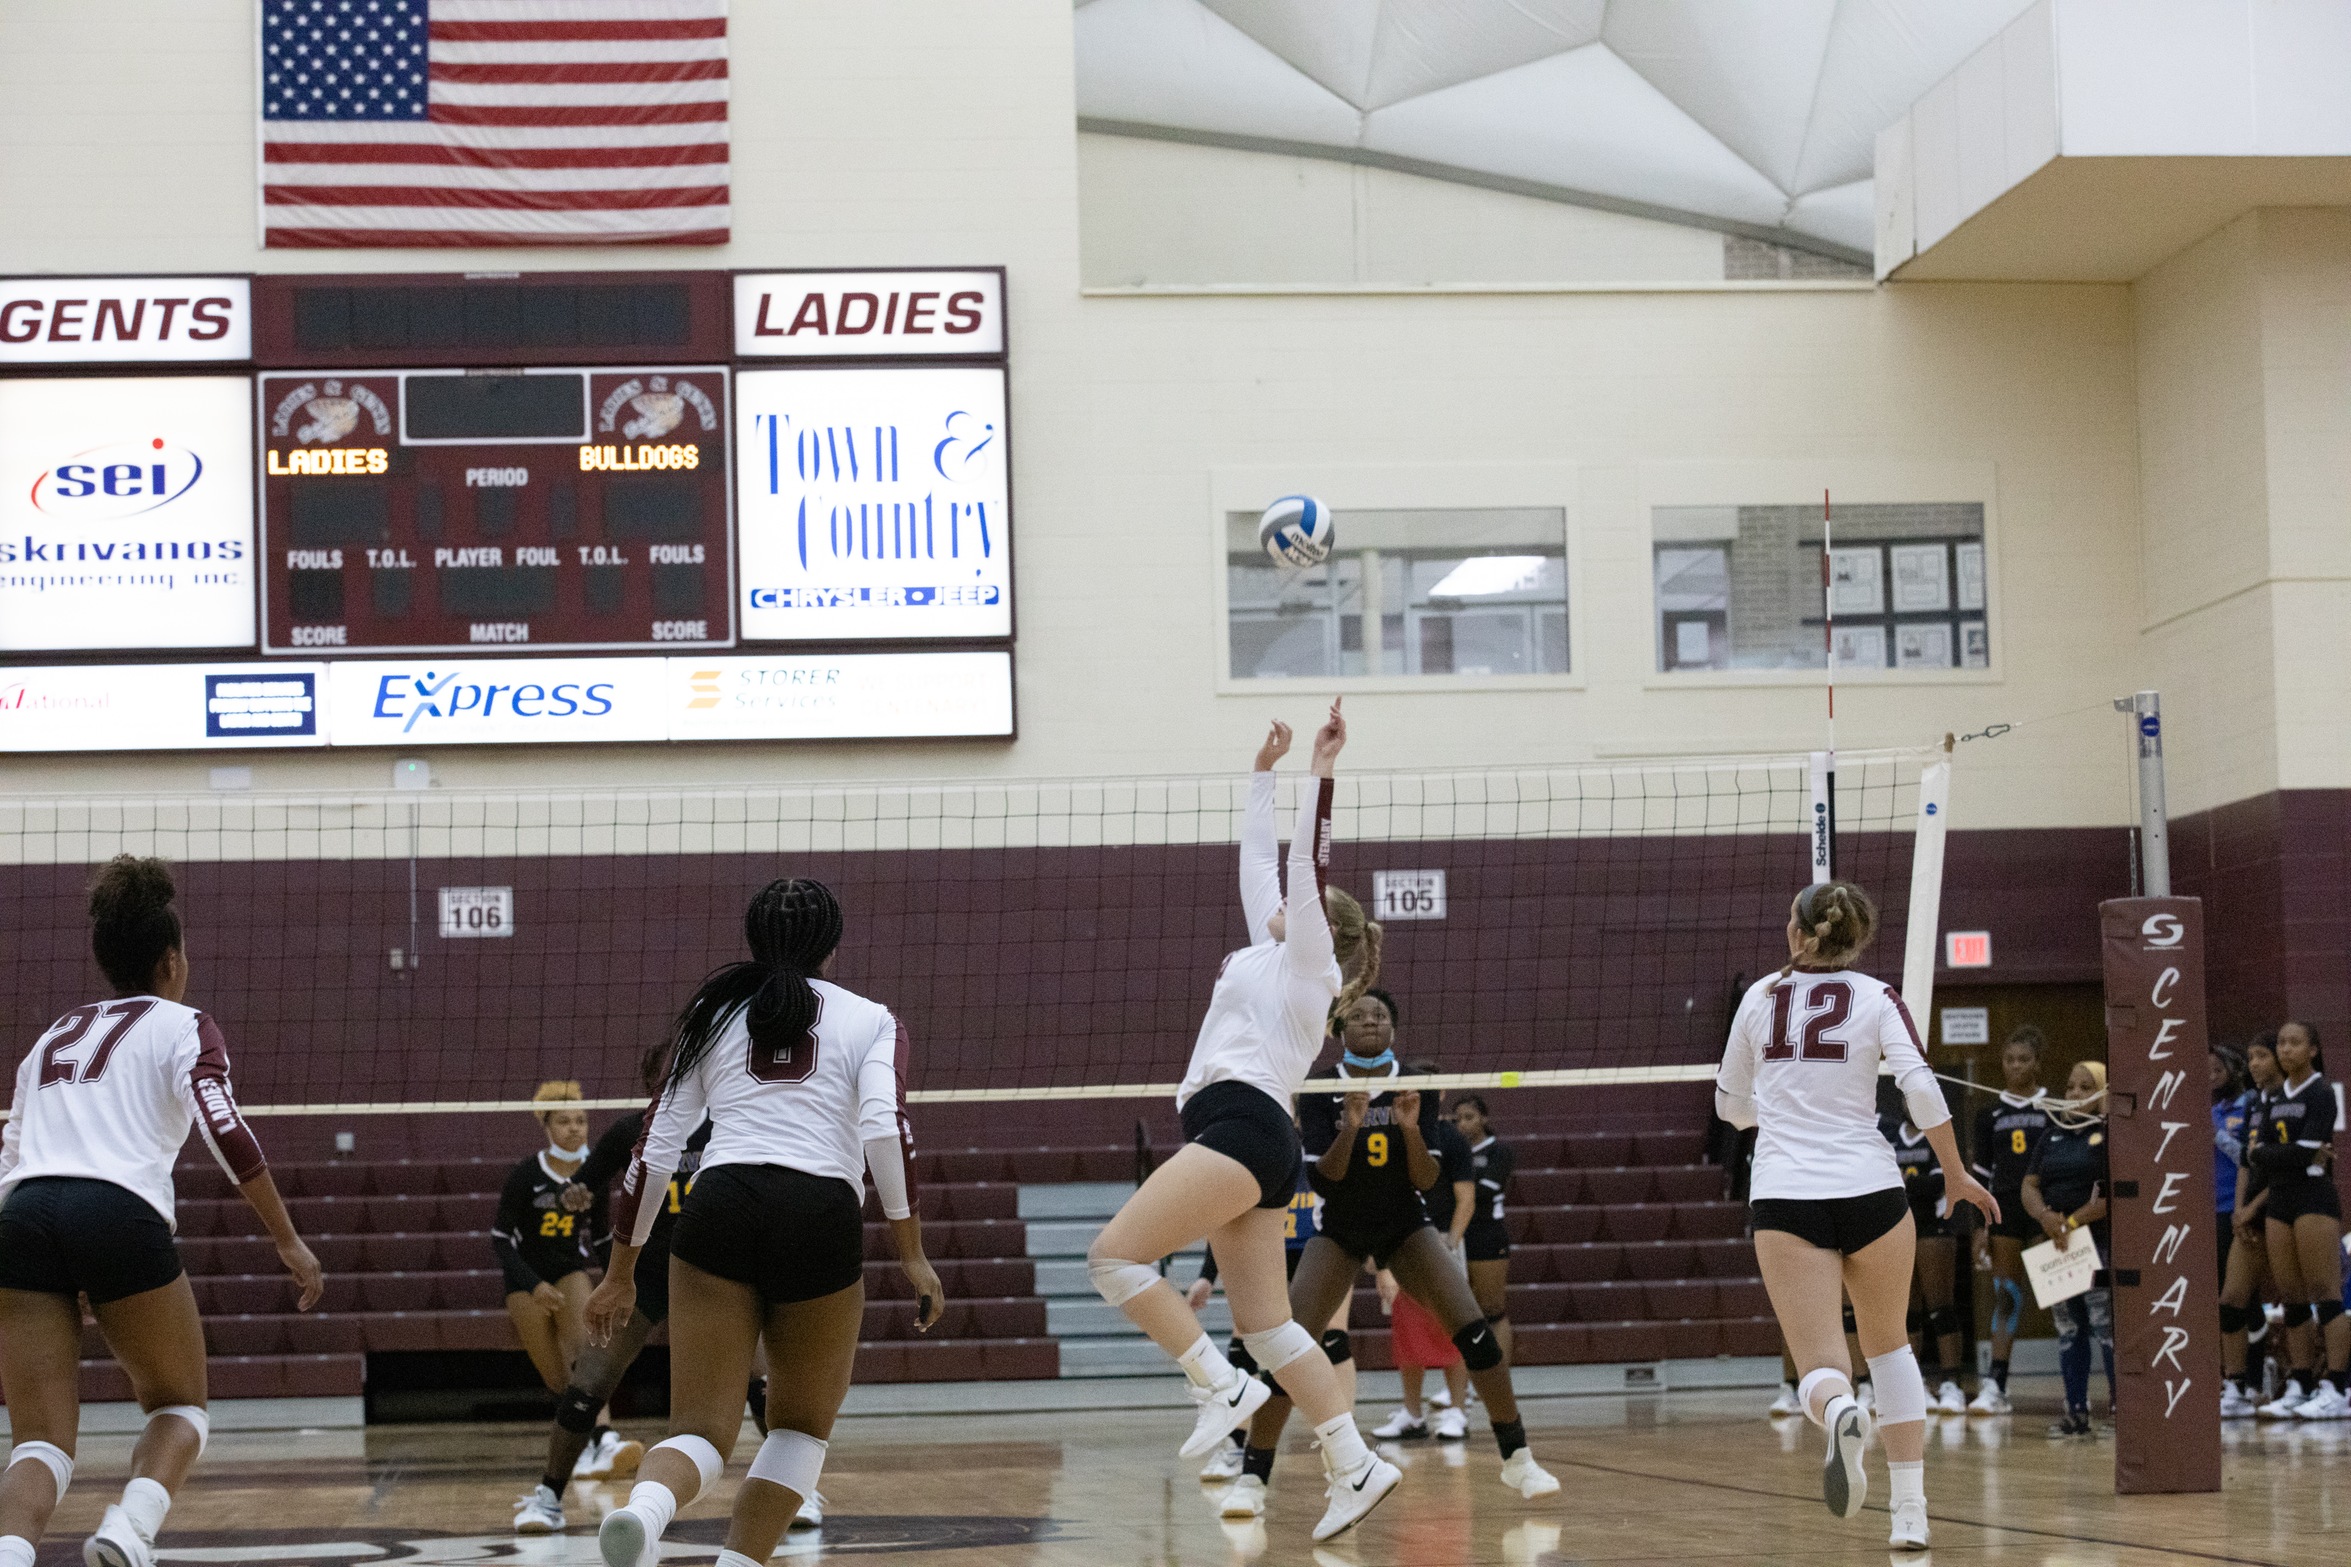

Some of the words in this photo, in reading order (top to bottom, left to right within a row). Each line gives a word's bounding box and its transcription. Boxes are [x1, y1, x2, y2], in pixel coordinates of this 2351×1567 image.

[0, 297, 233, 342] GENTS
[754, 290, 985, 337] LADIES
[268, 449, 389, 475] LADIES
[579, 444, 699, 471] BULLDOGS
[755, 414, 899, 495] Town
[934, 410, 994, 483] &
[56, 438, 167, 497] sei
[466, 467, 528, 487] PERIOD
[797, 492, 999, 577] Country
[0, 536, 243, 563] skrivanos
[287, 550, 343, 569] FOULS
[365, 549, 417, 568] T.O.L.
[435, 548, 502, 568] PLAYER
[516, 547, 560, 566] FOUL
[578, 547, 628, 566] T.O.L.
[650, 546, 705, 564] FOULS
[755, 587, 906, 608] CHRYSLER
[928, 586, 998, 606] JEEP
[291, 626, 347, 646] SCORE
[470, 623, 528, 643] MATCH
[652, 621, 707, 640] SCORE
[740, 668, 840, 687] STORER
[1816, 815, 1826, 866] Schelde
[1388, 890, 1433, 912] 105
[452, 906, 501, 929] 106
[1762, 980, 1855, 1062] 12
[38, 1000, 159, 1091] 27
[1367, 1133, 1388, 1167] 9
[2011, 1129, 2027, 1154] 8
[2146, 967, 2191, 1418] CENTENARY
[540, 1211, 575, 1237] 24
